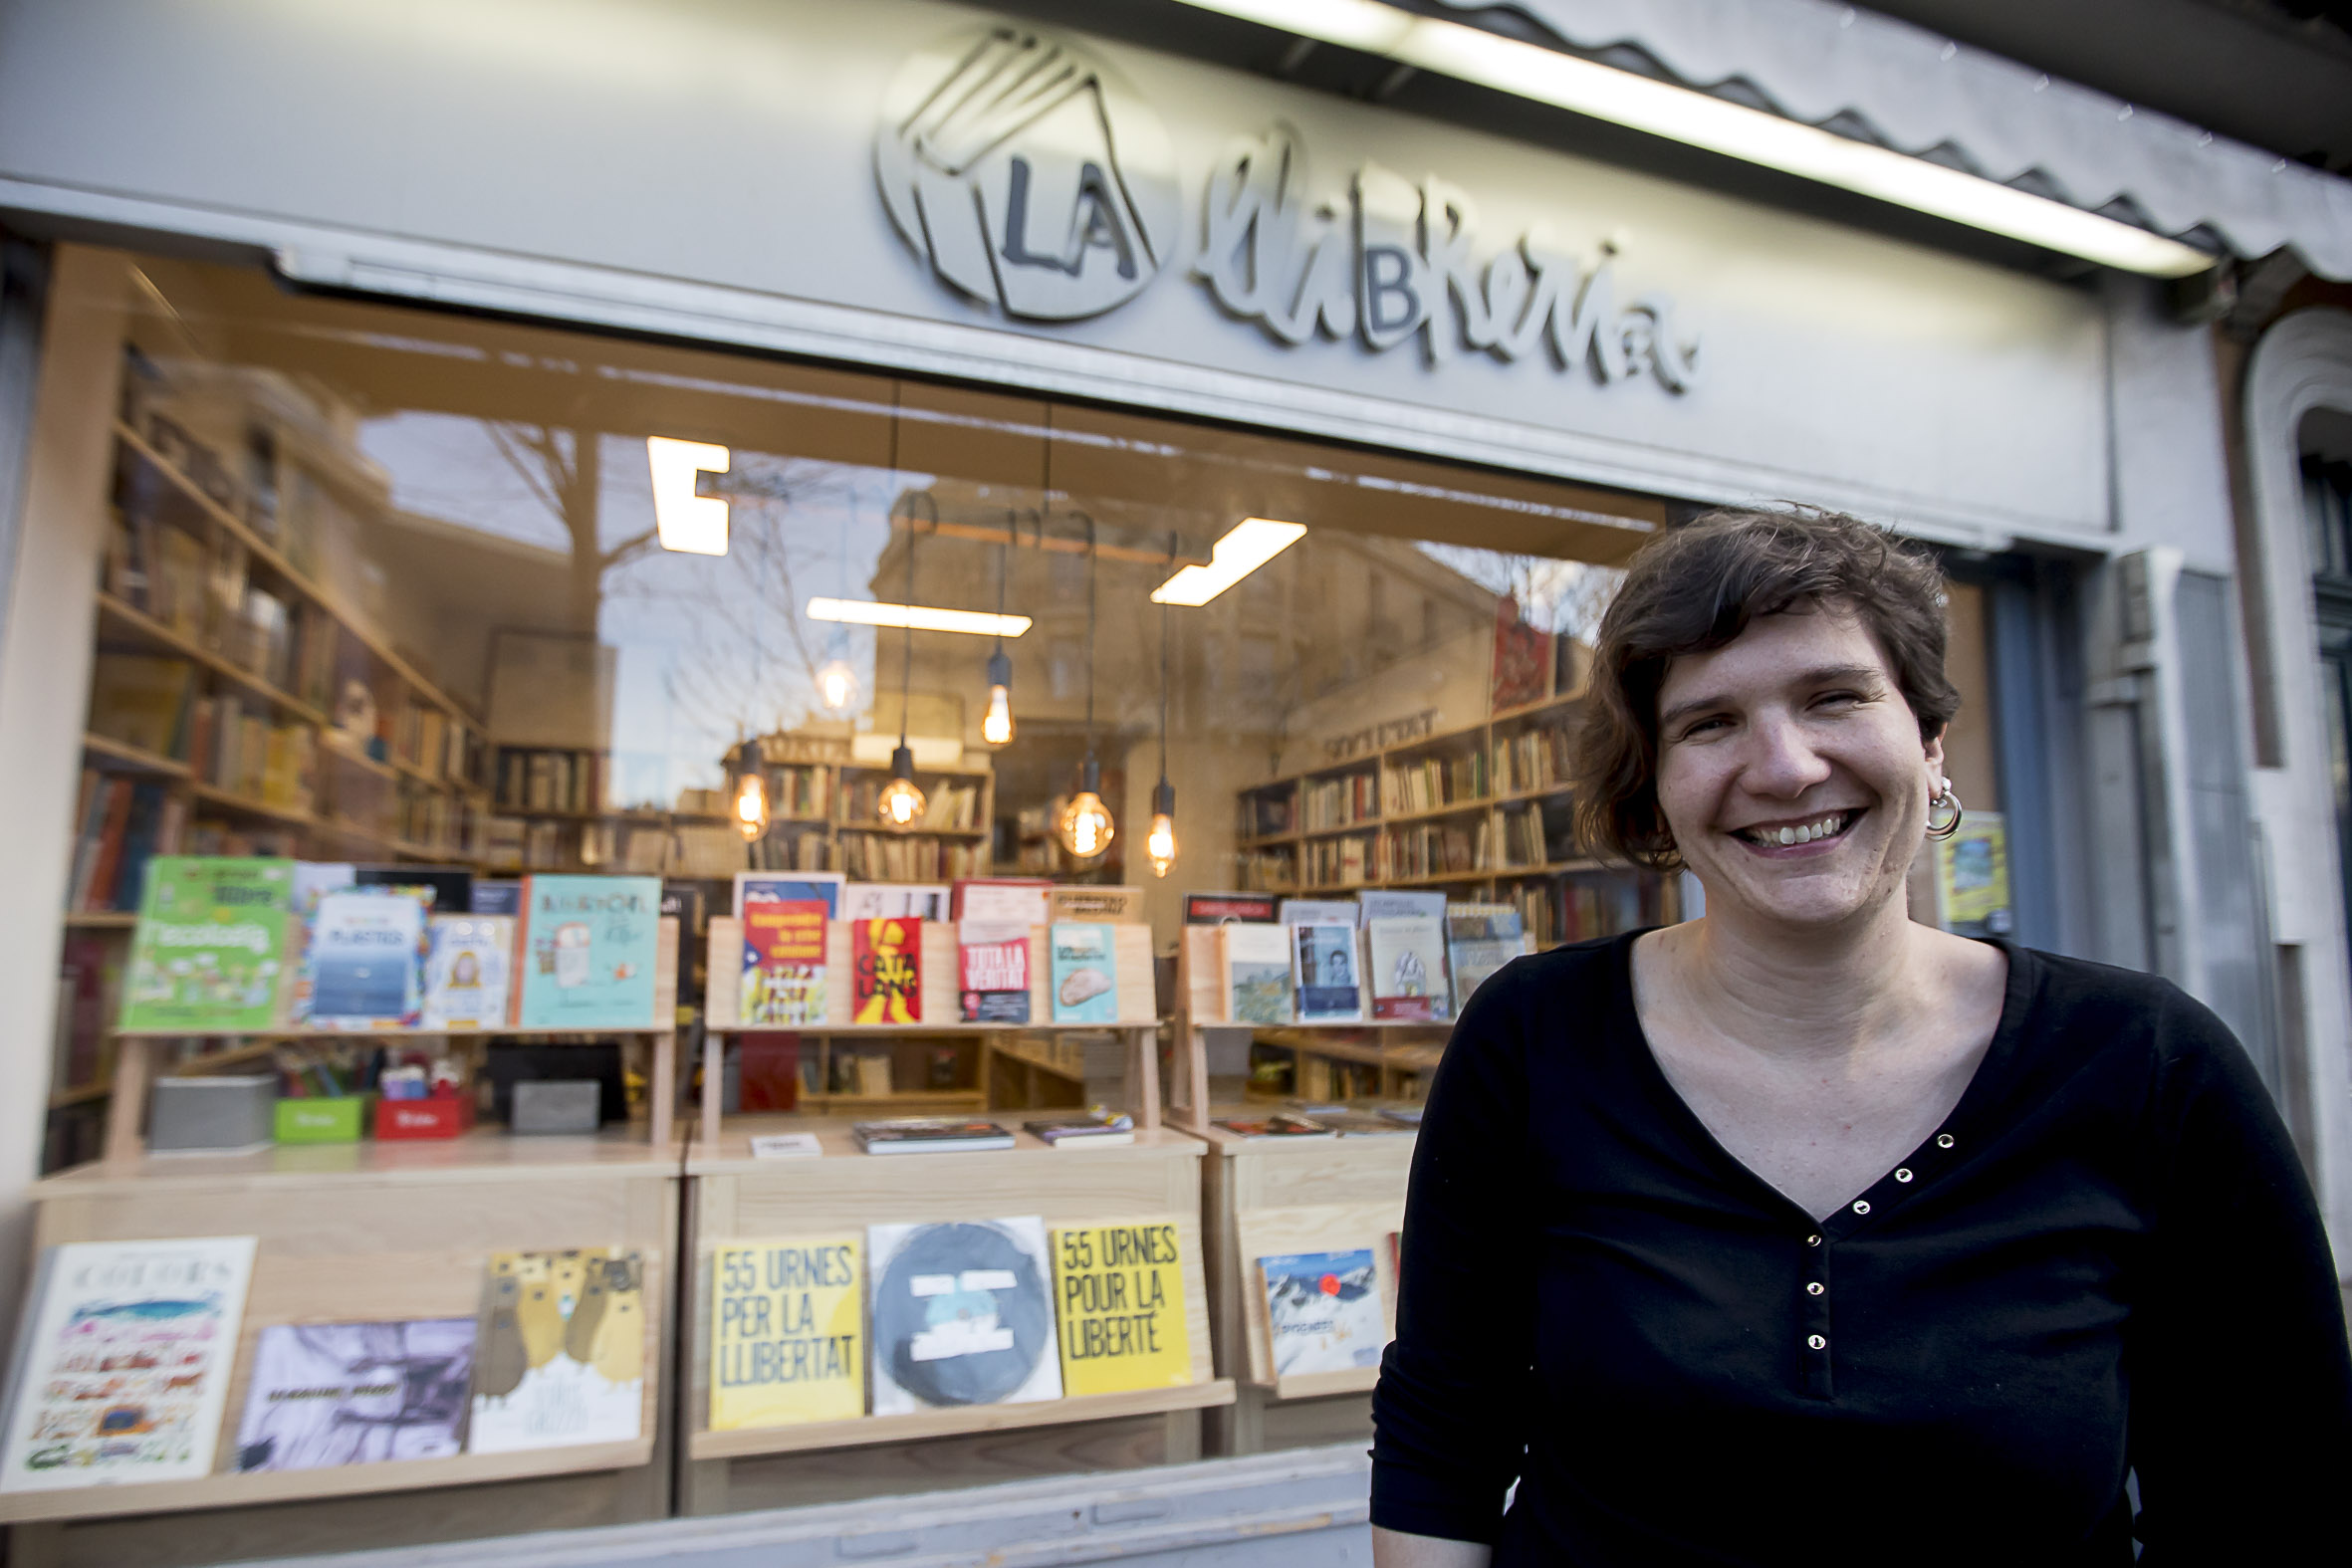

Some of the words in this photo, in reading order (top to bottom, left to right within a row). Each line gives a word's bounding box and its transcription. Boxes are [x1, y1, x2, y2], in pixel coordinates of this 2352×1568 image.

[1001, 154, 1138, 281] LA
[857, 953, 918, 977] CATA
[857, 975, 917, 1000] LANS
[722, 1249, 756, 1293] 55
[766, 1244, 853, 1291] URNES
[1062, 1231, 1093, 1270] 55
[1099, 1225, 1178, 1266] URNES
[1064, 1271, 1128, 1314] POUR
[1134, 1268, 1166, 1309] LA
[722, 1294, 772, 1339] PER
[783, 1292, 816, 1335] LA
[1067, 1309, 1164, 1361] LIBERTÉ
[720, 1334, 853, 1388] LLIBERTAT
